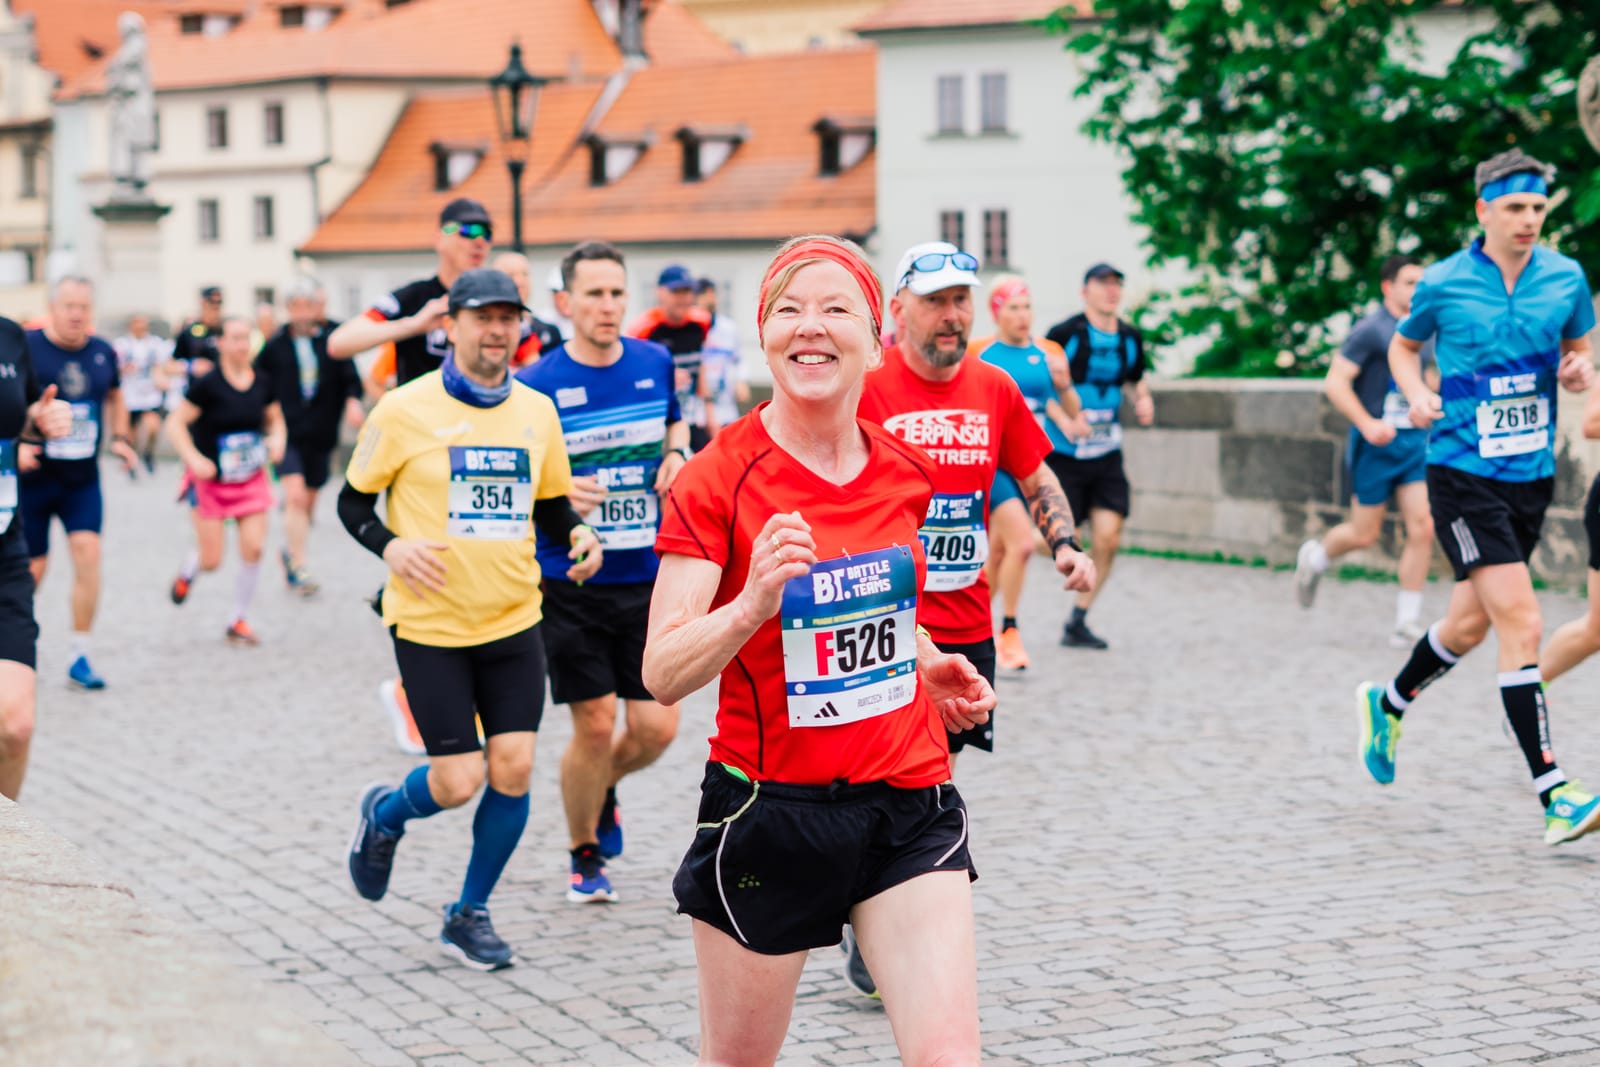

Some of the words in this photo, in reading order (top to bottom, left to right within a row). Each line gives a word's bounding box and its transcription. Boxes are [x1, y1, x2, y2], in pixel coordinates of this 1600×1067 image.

[1493, 404, 1538, 429] 2618
[472, 485, 513, 510] 354
[601, 498, 647, 522] 1663
[846, 559, 891, 580] BATTLE
[852, 578, 892, 597] TEAMS
[814, 617, 896, 676] F526
